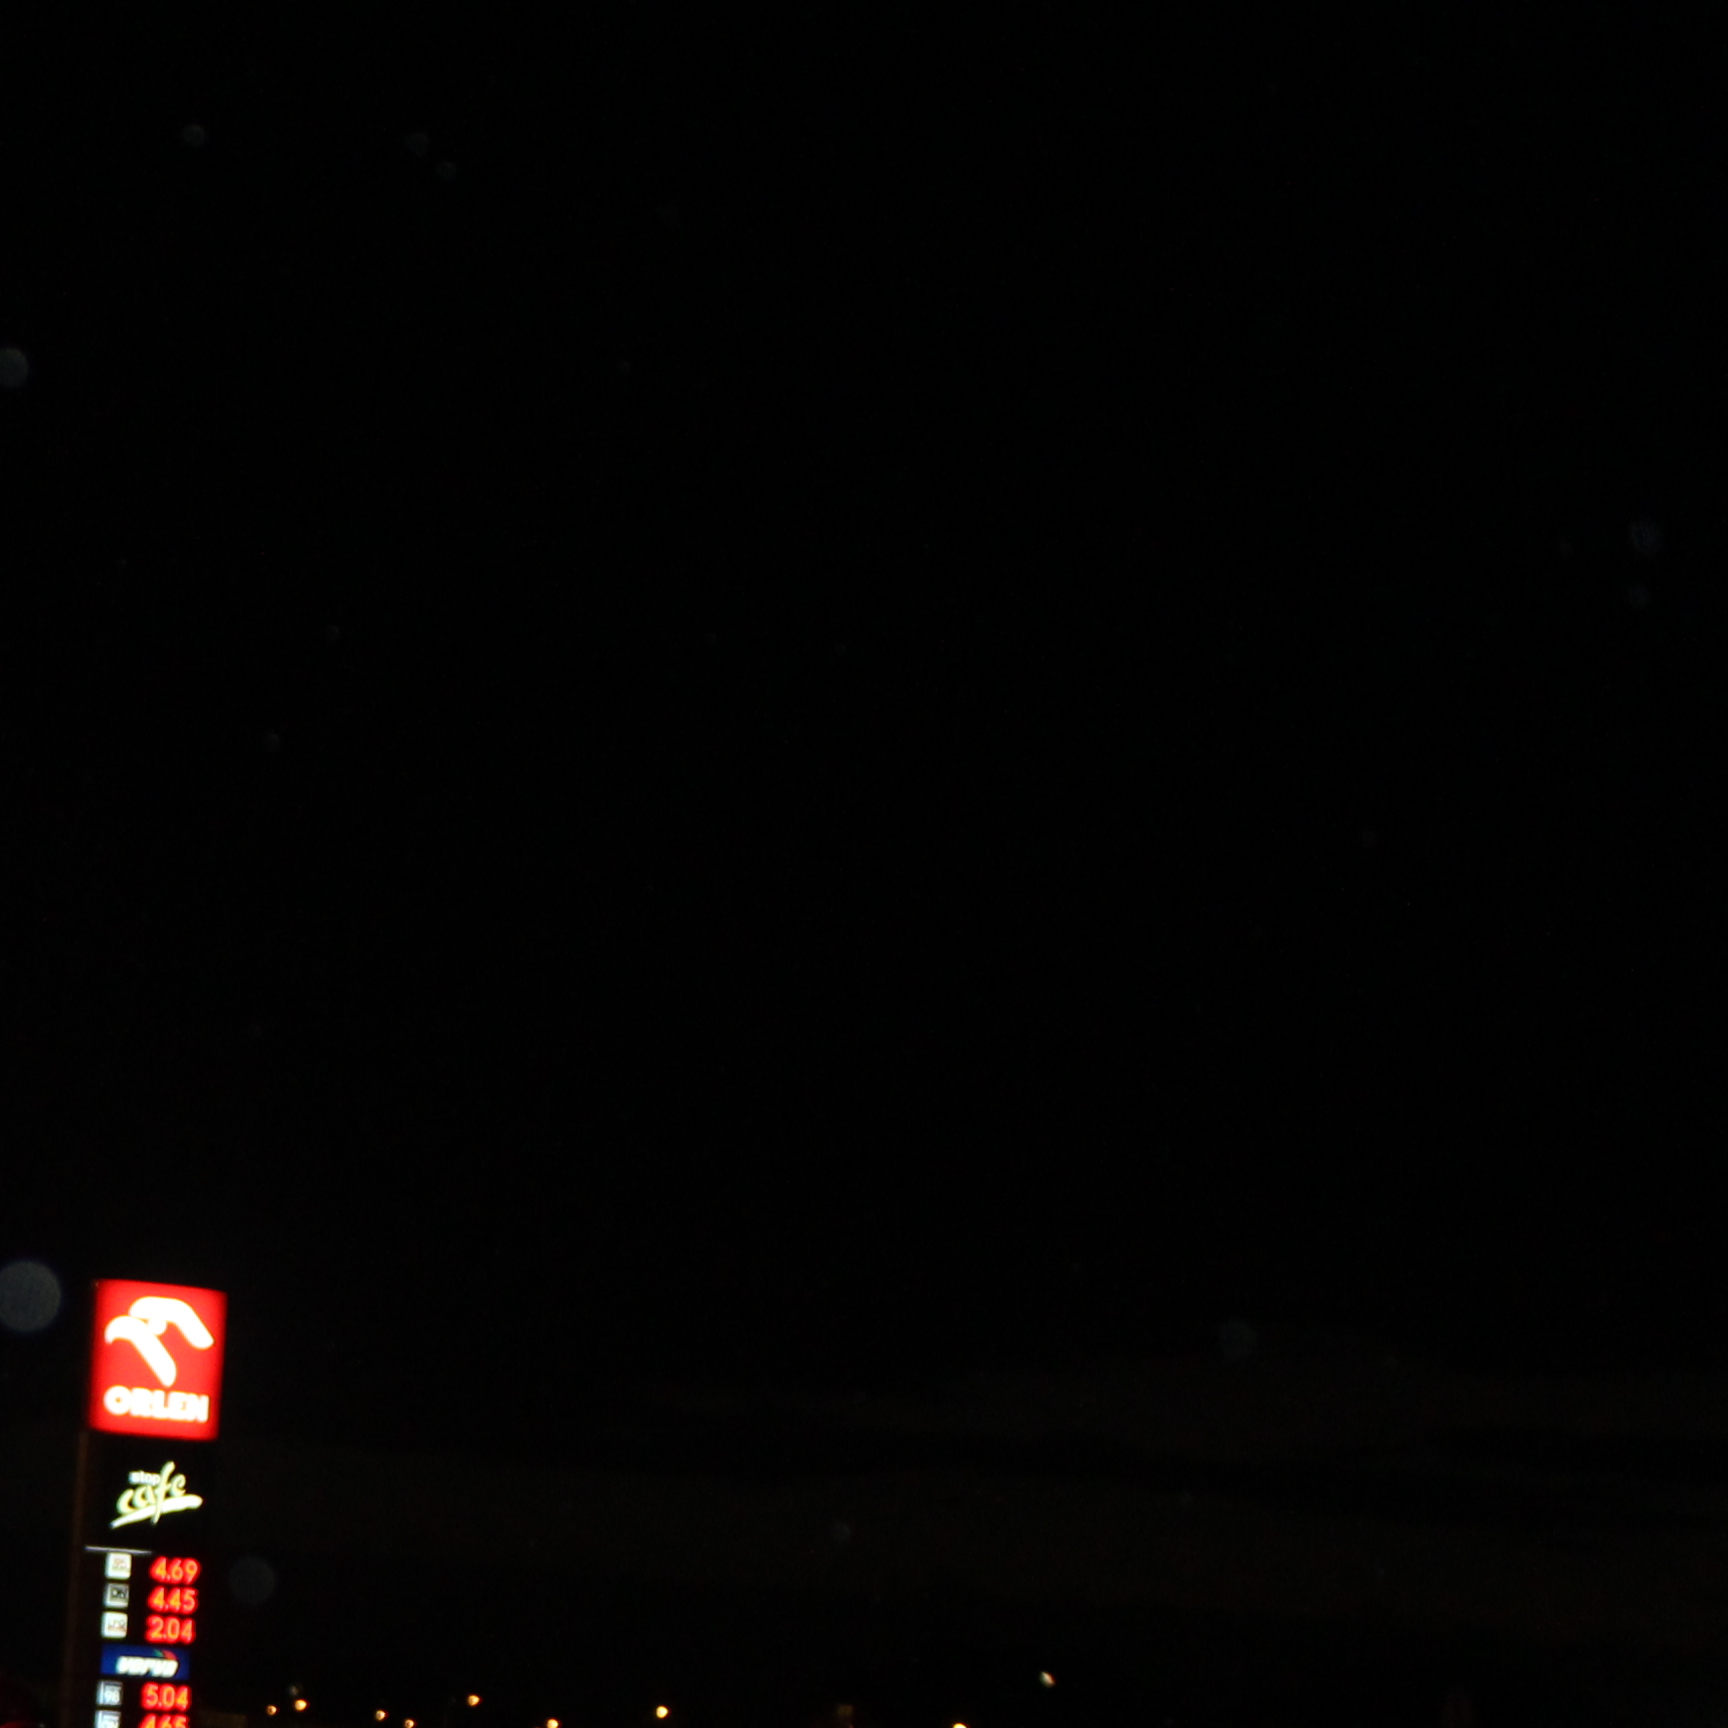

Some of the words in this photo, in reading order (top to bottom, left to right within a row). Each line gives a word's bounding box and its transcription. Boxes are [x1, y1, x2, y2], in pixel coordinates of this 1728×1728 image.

[103, 1385, 210, 1423] ORLEN
[152, 1556, 200, 1584] 4.69
[149, 1587, 197, 1614] 4.45
[147, 1616, 195, 1643] 2.04
[142, 1683, 190, 1710] 5.04
